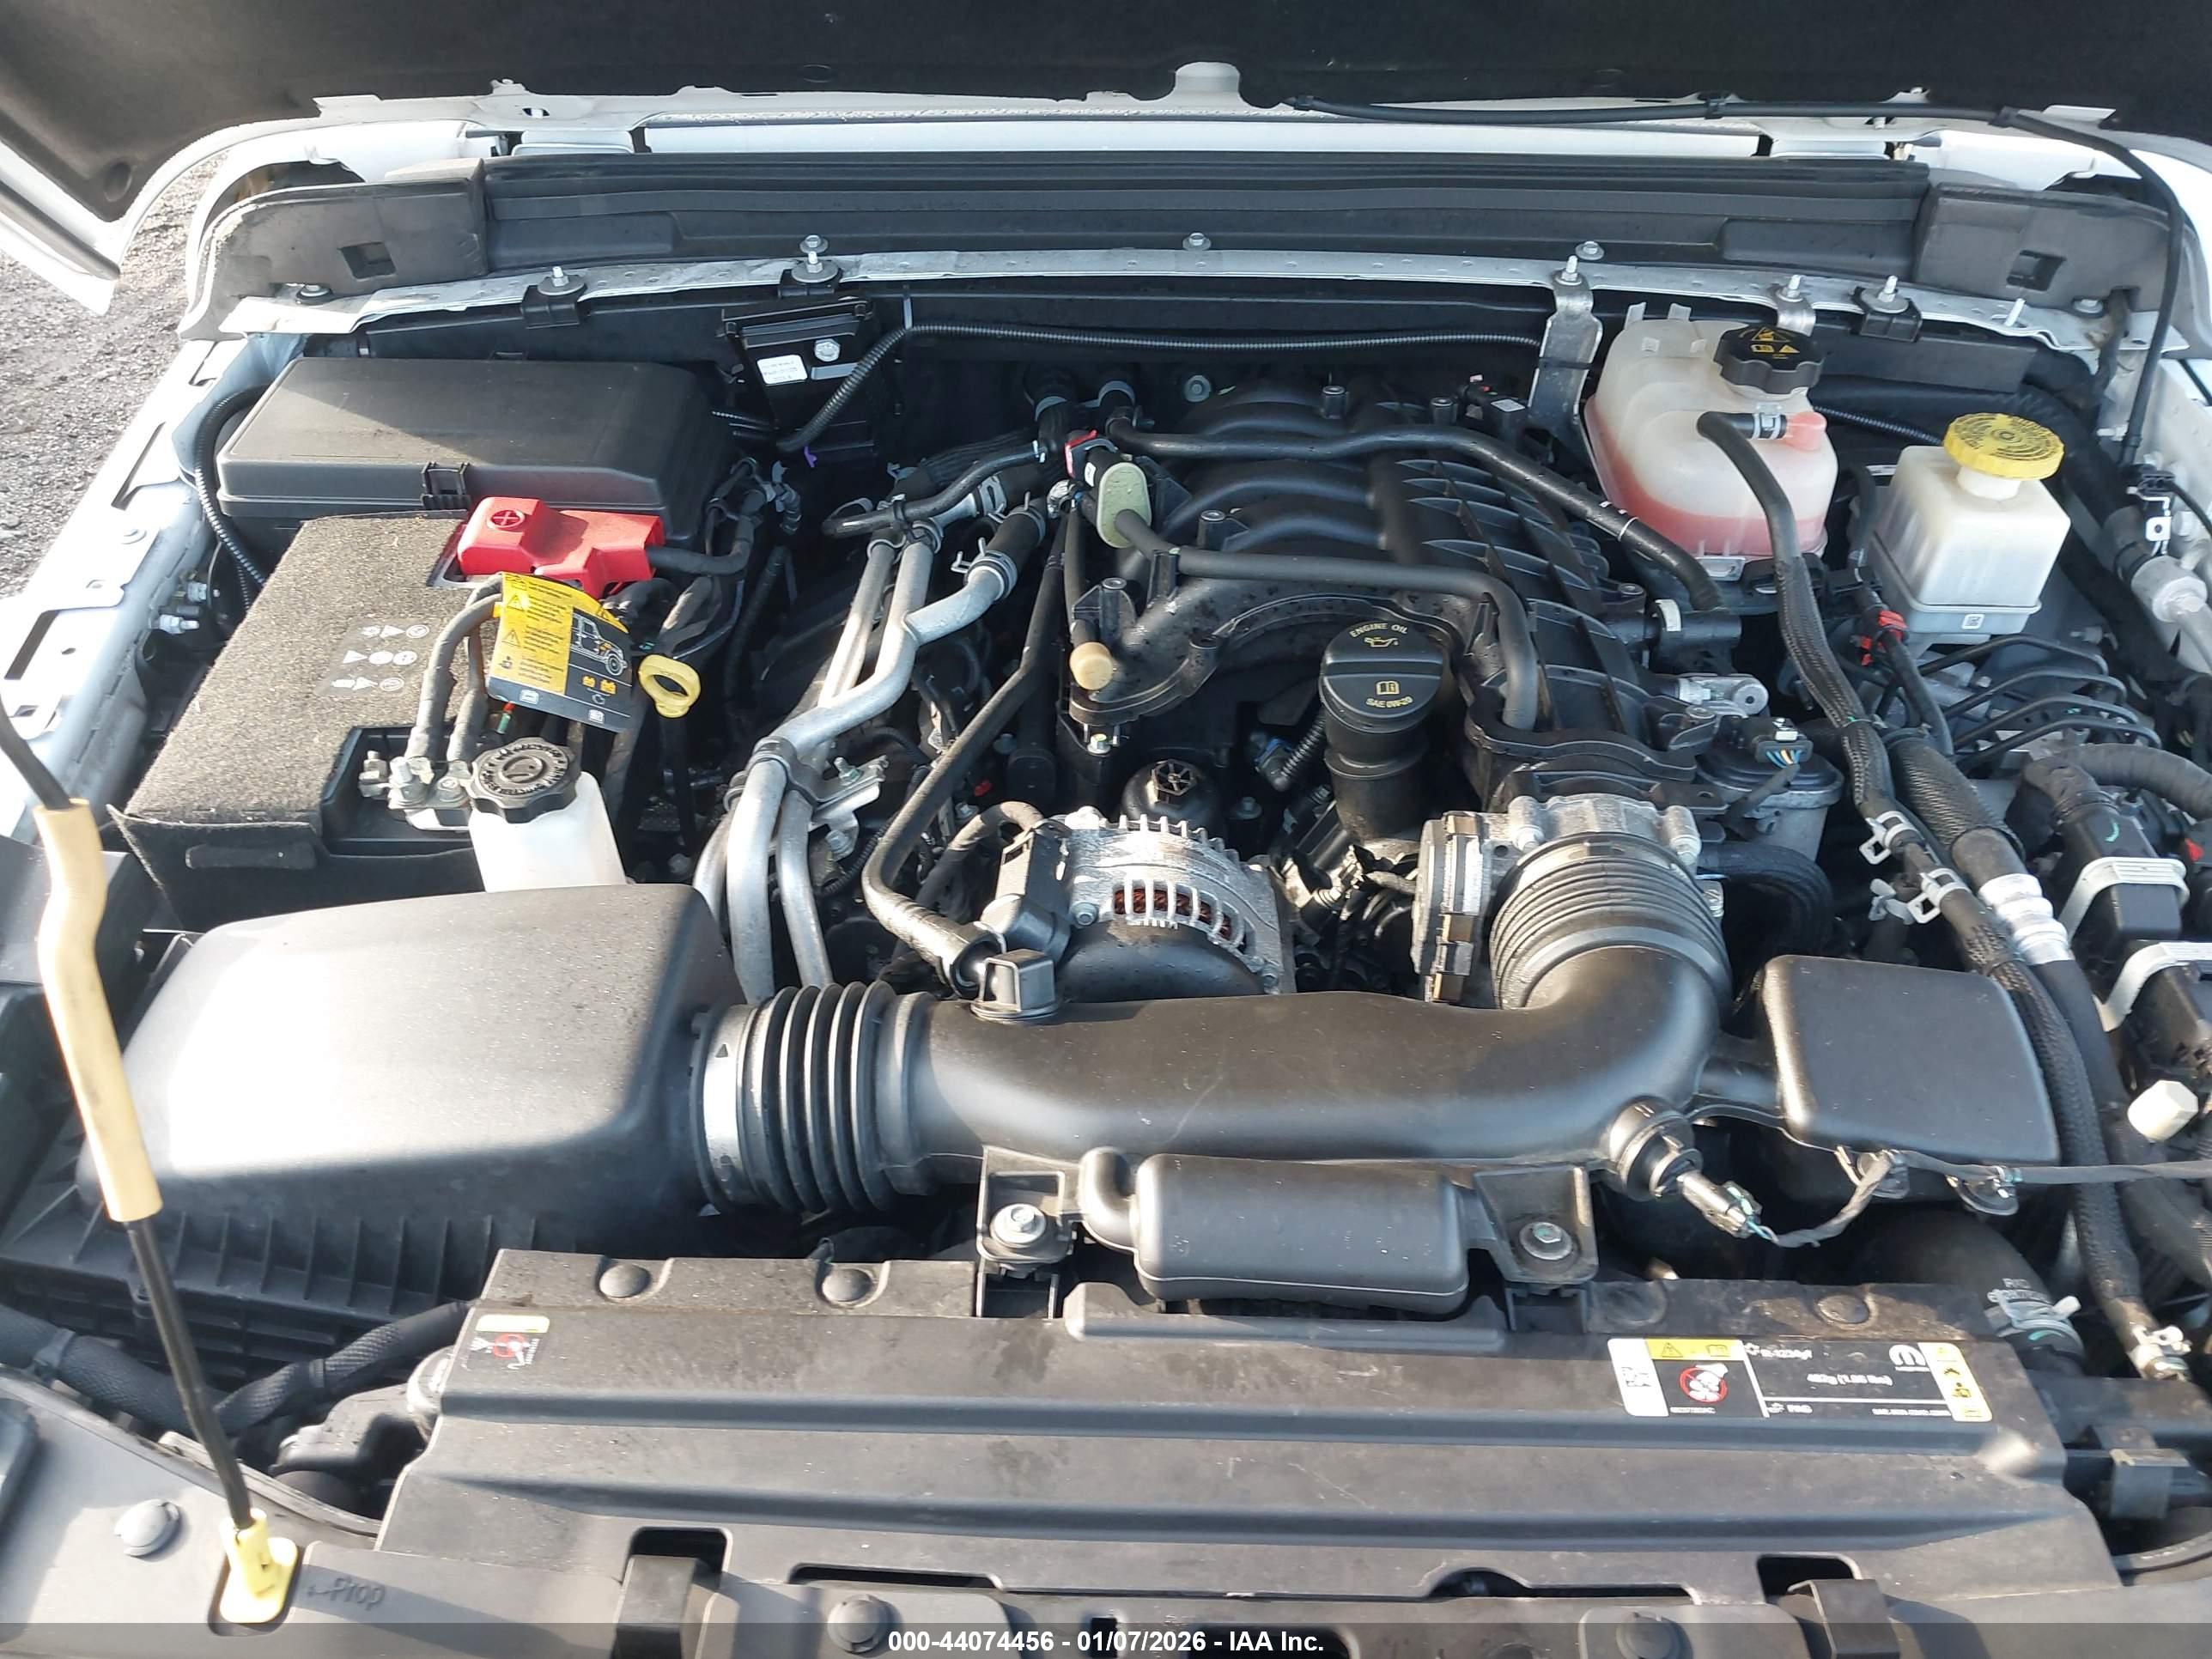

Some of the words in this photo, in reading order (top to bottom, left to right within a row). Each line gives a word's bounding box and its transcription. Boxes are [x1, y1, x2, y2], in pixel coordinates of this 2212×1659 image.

[1348, 623, 1389, 638] ENGINE
[1391, 623, 1409, 635] OIL
[1365, 697, 1387, 708] SAE
[330, 1577, 386, 1611] Prop
